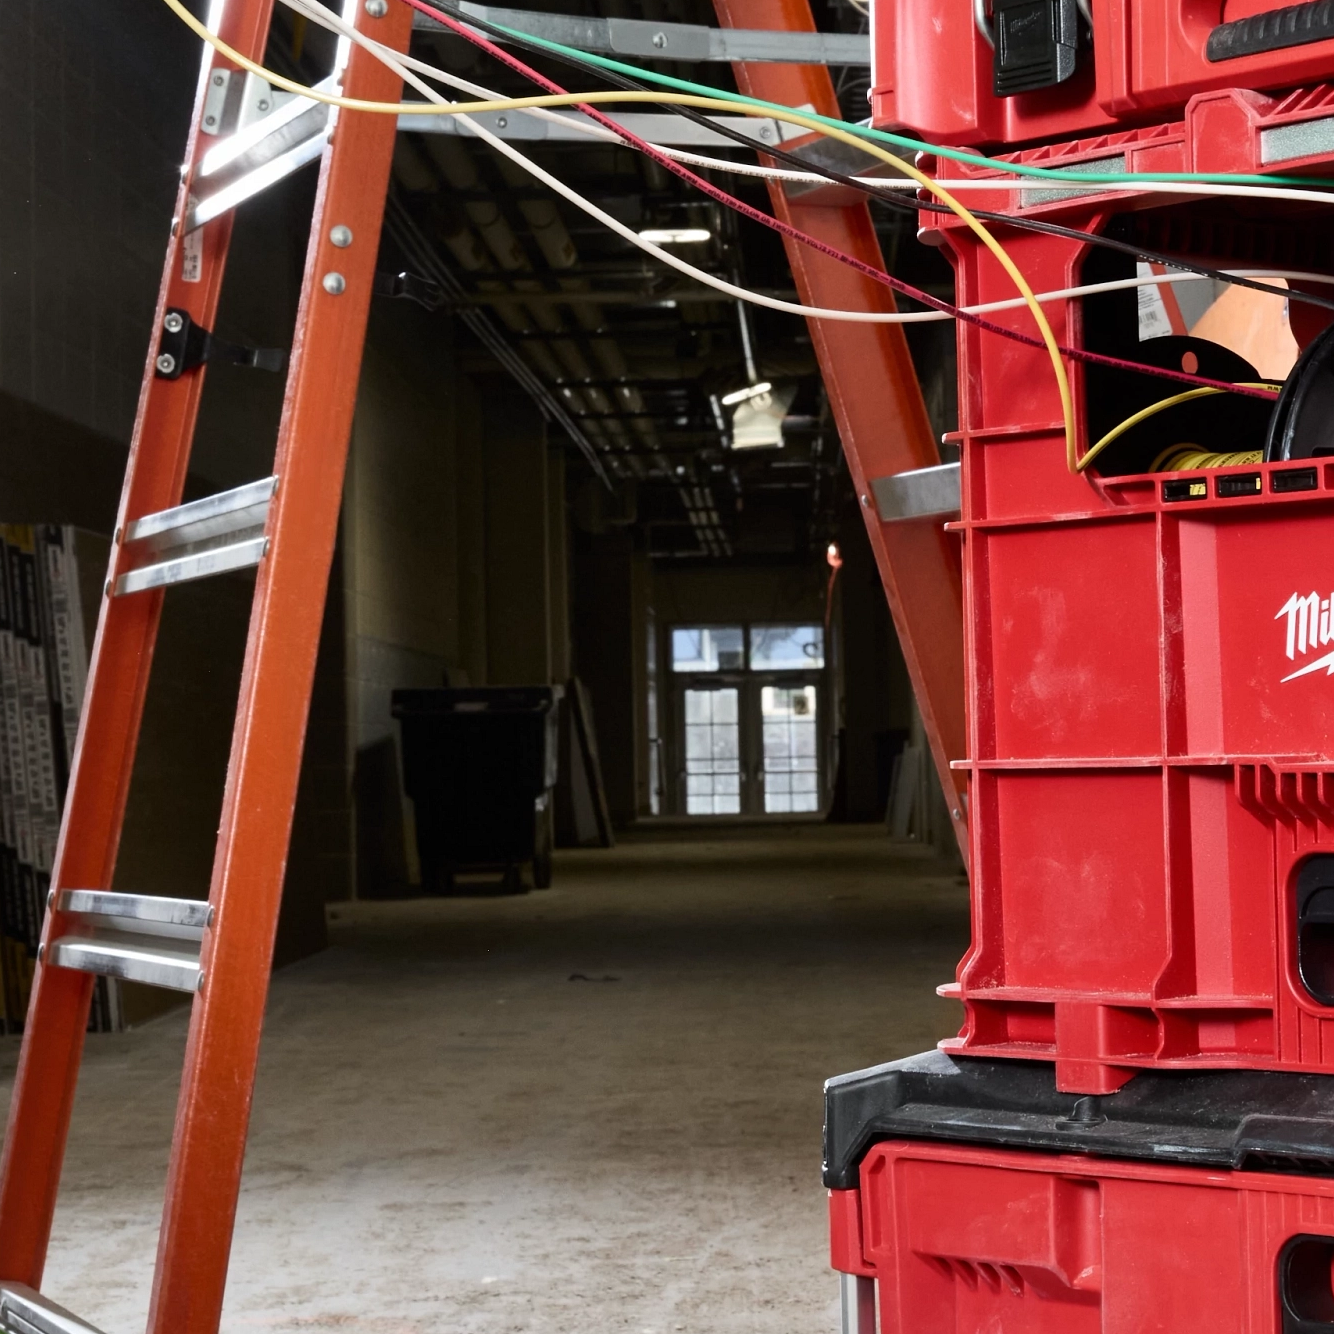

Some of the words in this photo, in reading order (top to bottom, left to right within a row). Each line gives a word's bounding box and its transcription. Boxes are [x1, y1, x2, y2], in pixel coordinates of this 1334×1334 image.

[670, 165, 681, 174] OR
[681, 171, 698, 184] AWM
[760, 215, 771, 224] OR
